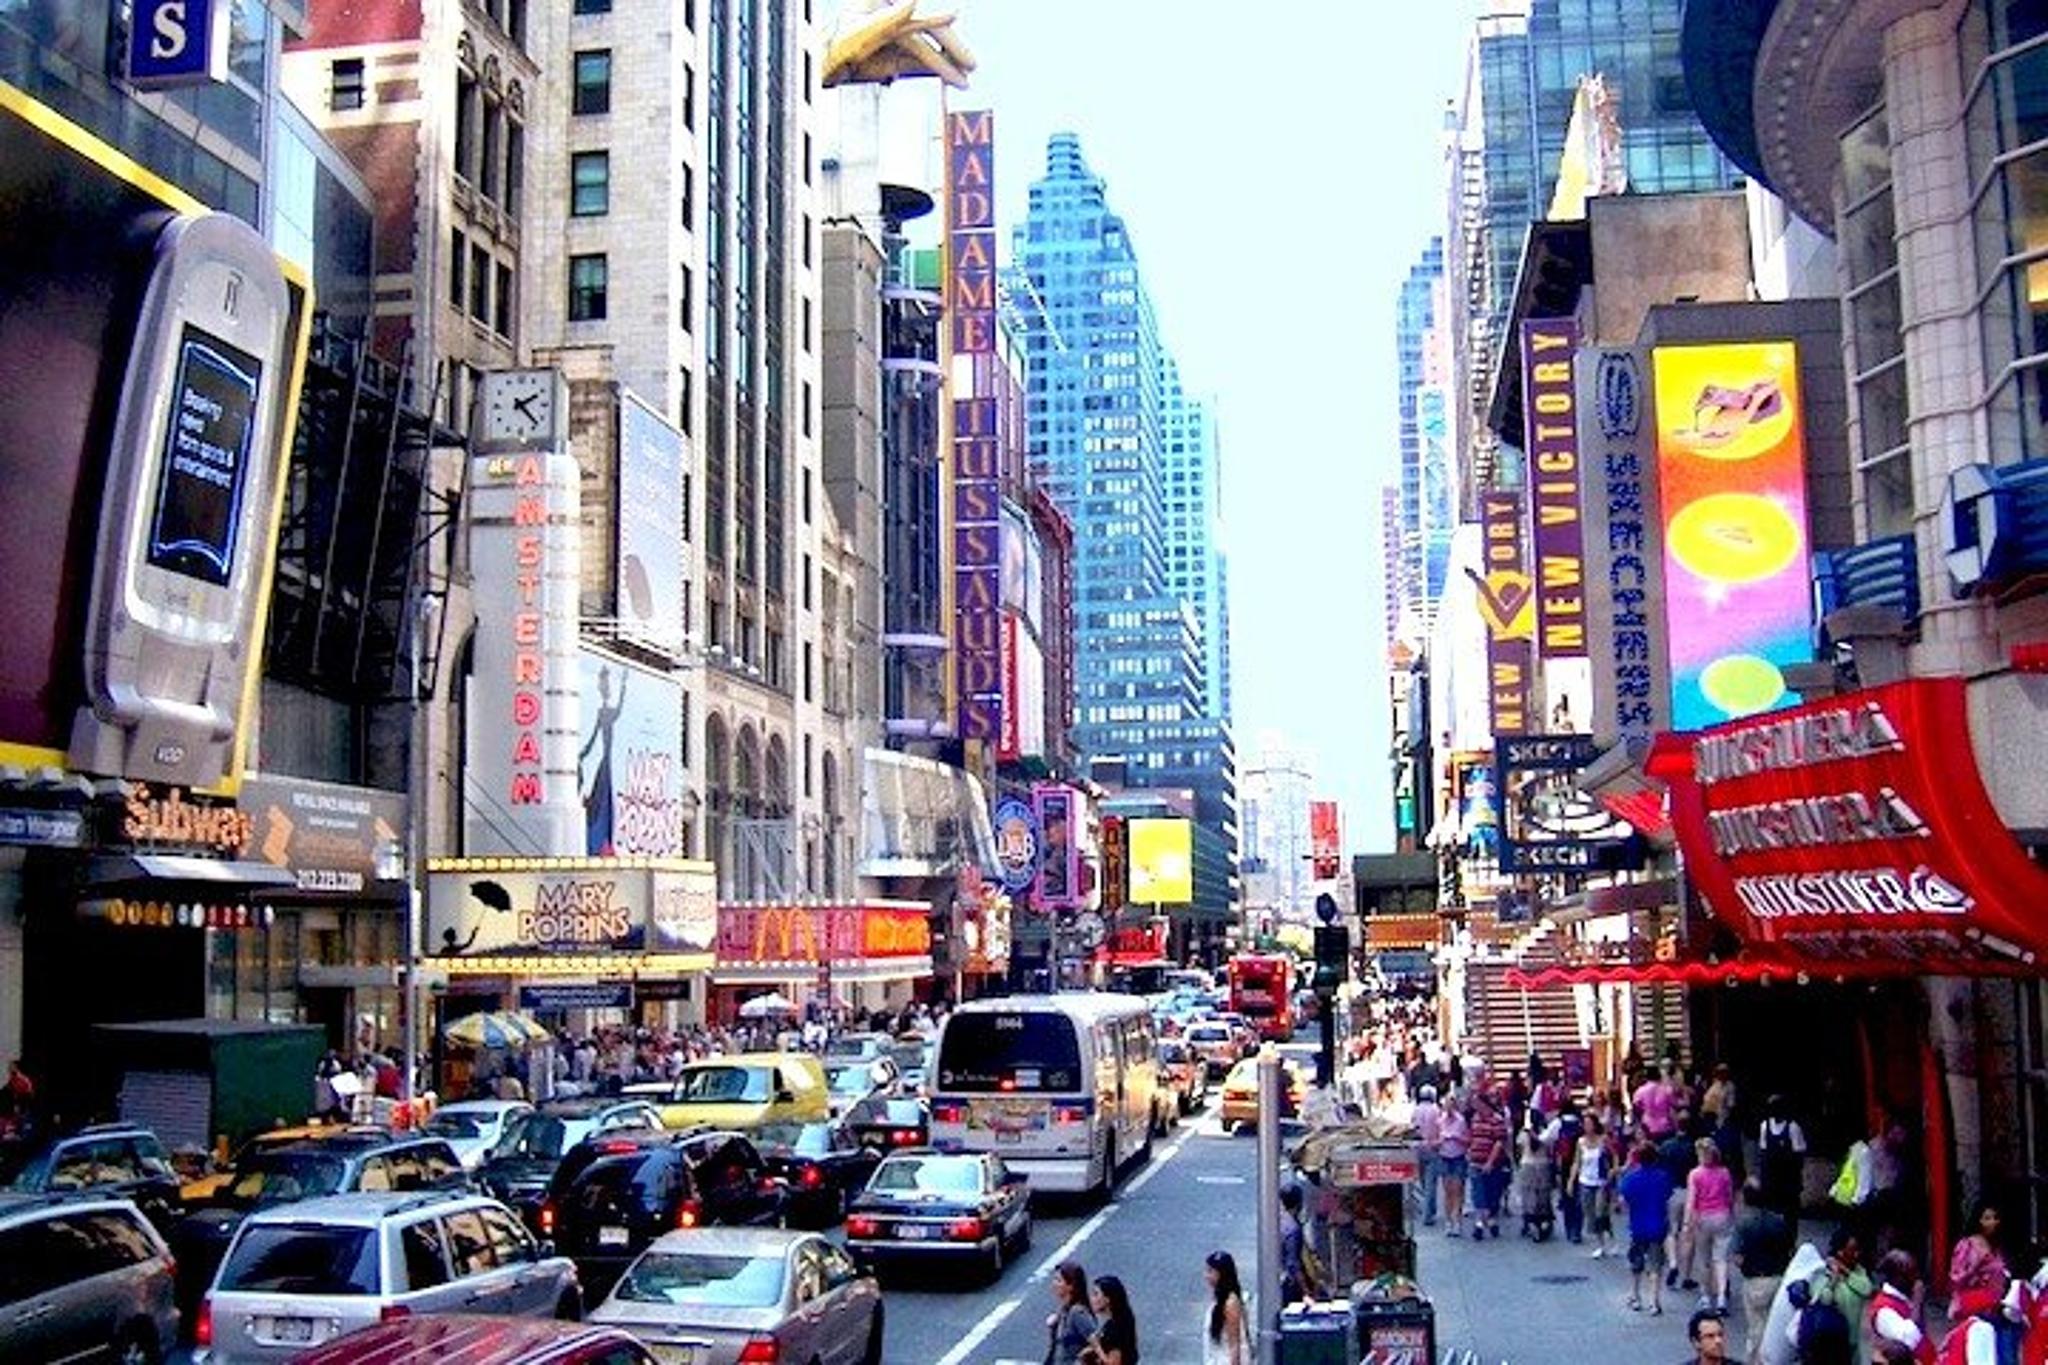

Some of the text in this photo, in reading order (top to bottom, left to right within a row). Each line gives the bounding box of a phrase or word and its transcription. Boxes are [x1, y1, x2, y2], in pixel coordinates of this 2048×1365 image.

[151, 1, 187, 58] S
[954, 111, 993, 350] MADAME
[1532, 332, 1583, 648] NEW VICTORY
[510, 455, 547, 805] AMSTERDAM
[957, 399, 996, 737] TUSSAUDS
[1605, 451, 1653, 728] SKECHERS
[1492, 661, 1523, 731] NEW
[517, 908, 630, 945] POPPINS
[536, 881, 615, 914] MARY
[1735, 868, 1910, 919] QUIKSILVER
